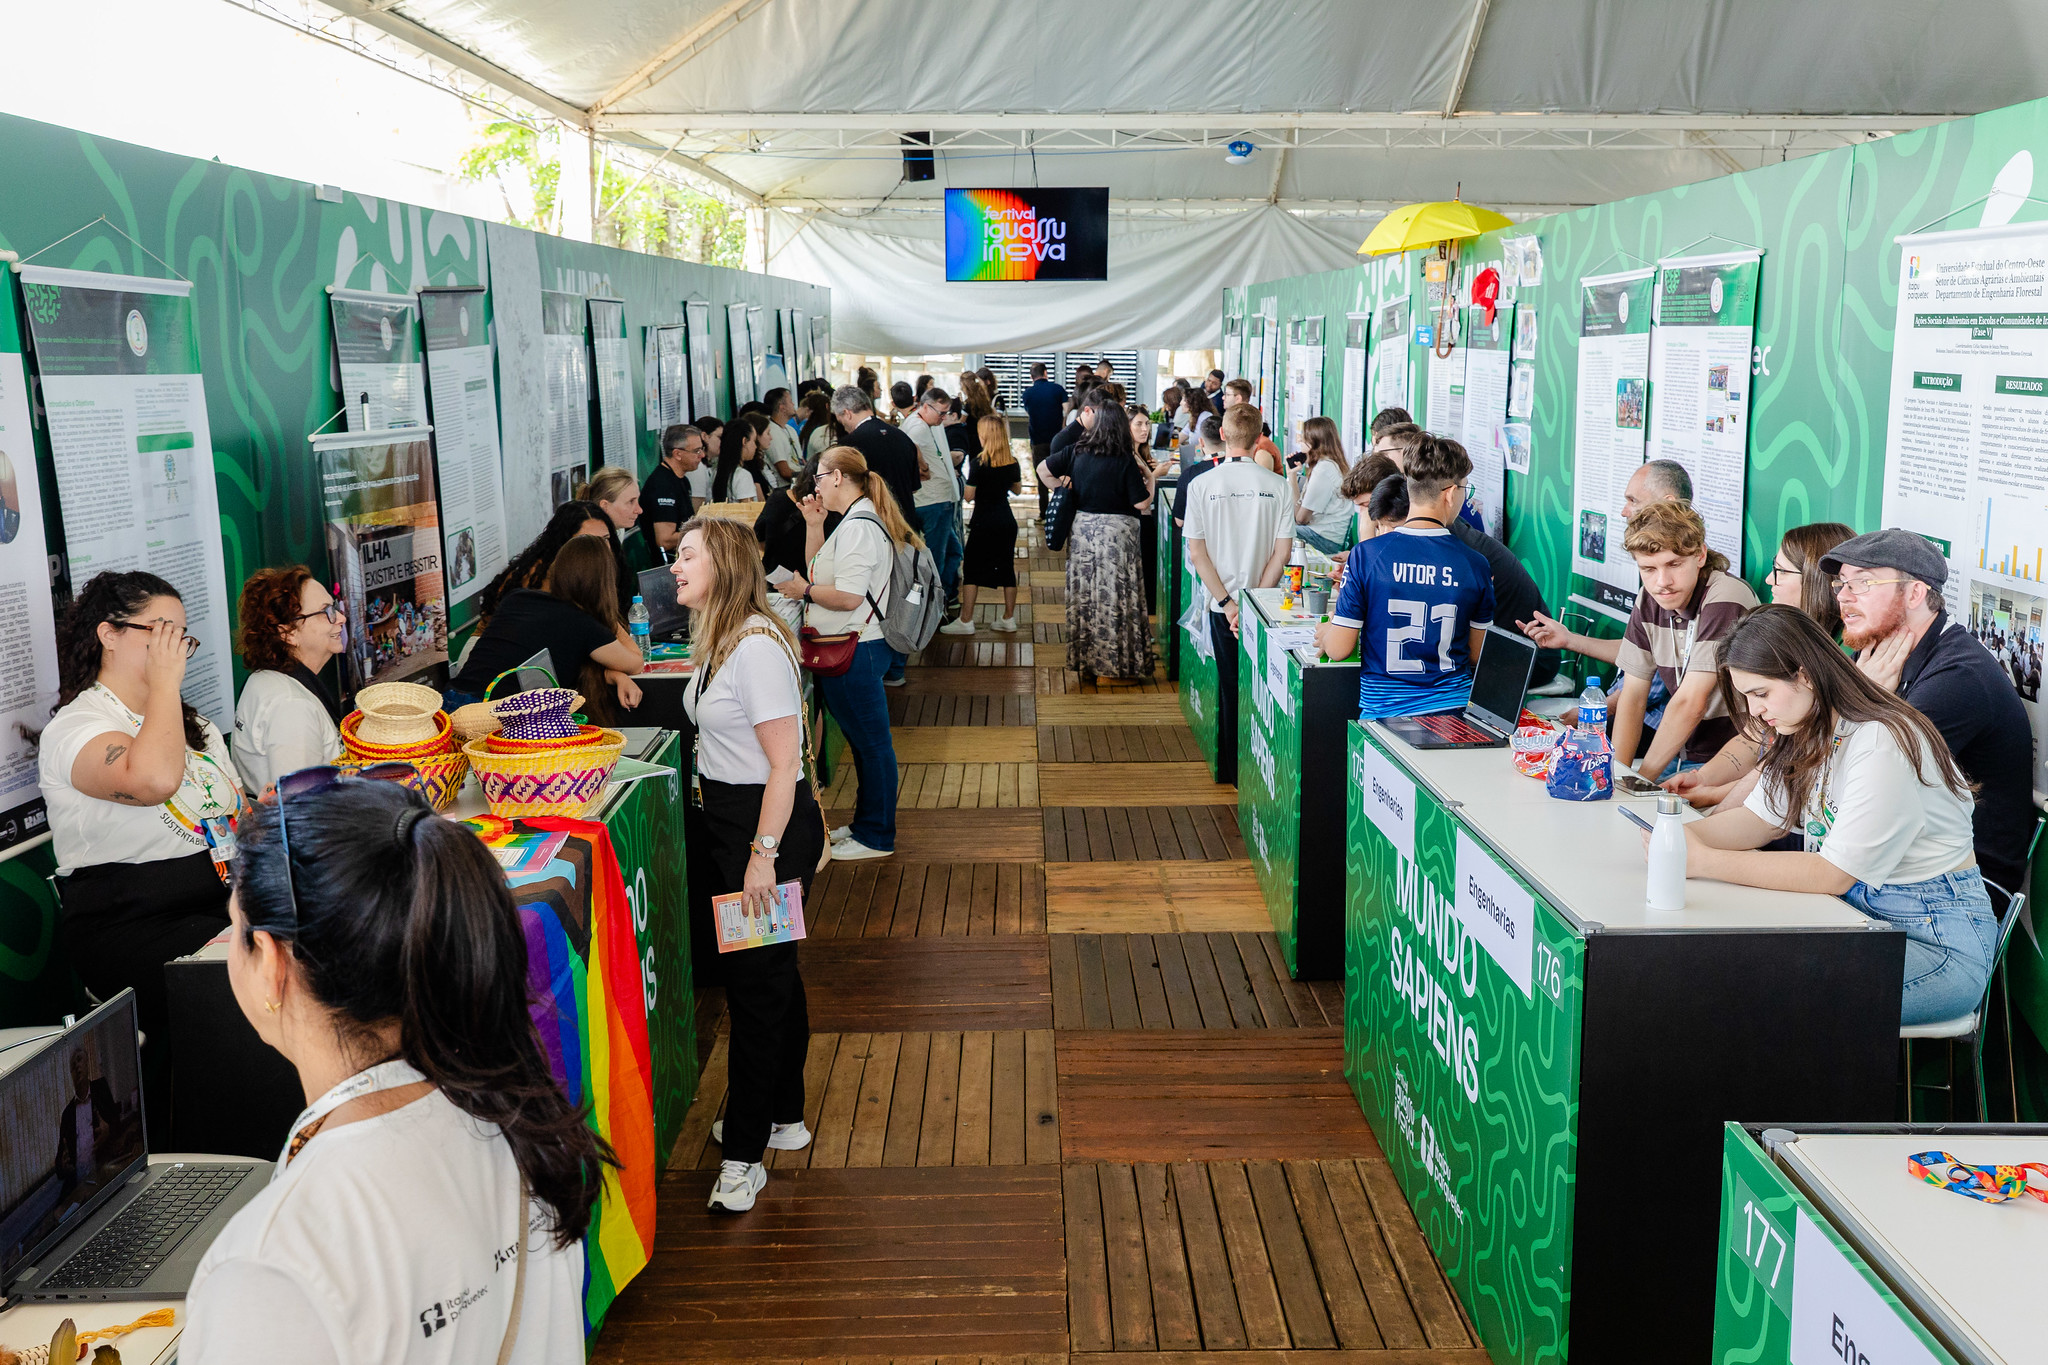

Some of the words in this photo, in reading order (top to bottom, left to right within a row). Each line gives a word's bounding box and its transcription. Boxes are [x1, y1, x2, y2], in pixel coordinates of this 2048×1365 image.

[983, 205, 1035, 220] festival
[1935, 278, 1948, 286] Setor
[1950, 277, 1956, 286] de
[1957, 275, 1979, 286] Ciências
[1980, 274, 2004, 287] Agrárias
[2009, 272, 2044, 284] Ambientais
[1996, 260, 2003, 270] do
[2004, 258, 2045, 270] Centro-Oeste
[1935, 288, 1972, 301] Departamento
[1973, 290, 1980, 299] de
[1982, 287, 2014, 300] Engenharia
[2015, 286, 2042, 298] Florestal
[1921, 376, 1953, 388] INTRODUÇÃO
[2005, 381, 2043, 392] RESULTADOS
[363, 540, 391, 564] ILHA
[366, 564, 396, 587] EXISTIR
[398, 565, 403, 579] E
[404, 555, 438, 577] RESISTIR
[1393, 562, 1436, 585] VITOR
[1442, 567, 1459, 587] S.
[1386, 599, 1458, 674] 21
[1251, 713, 1275, 801] SAPIENS
[1372, 777, 1404, 821] Engenharias
[160, 812, 208, 847] SUSTENTABIL
[1469, 874, 1515, 939] Engenharias
[1397, 853, 1477, 998] MUNDO
[1536, 942, 1560, 1000] 176
[1390, 926, 1479, 1103] SAPIENS
[1434, 1141, 1451, 1181] itaipu
[1434, 1165, 1463, 1225] parquetec
[1743, 1200, 1786, 1289] 177
